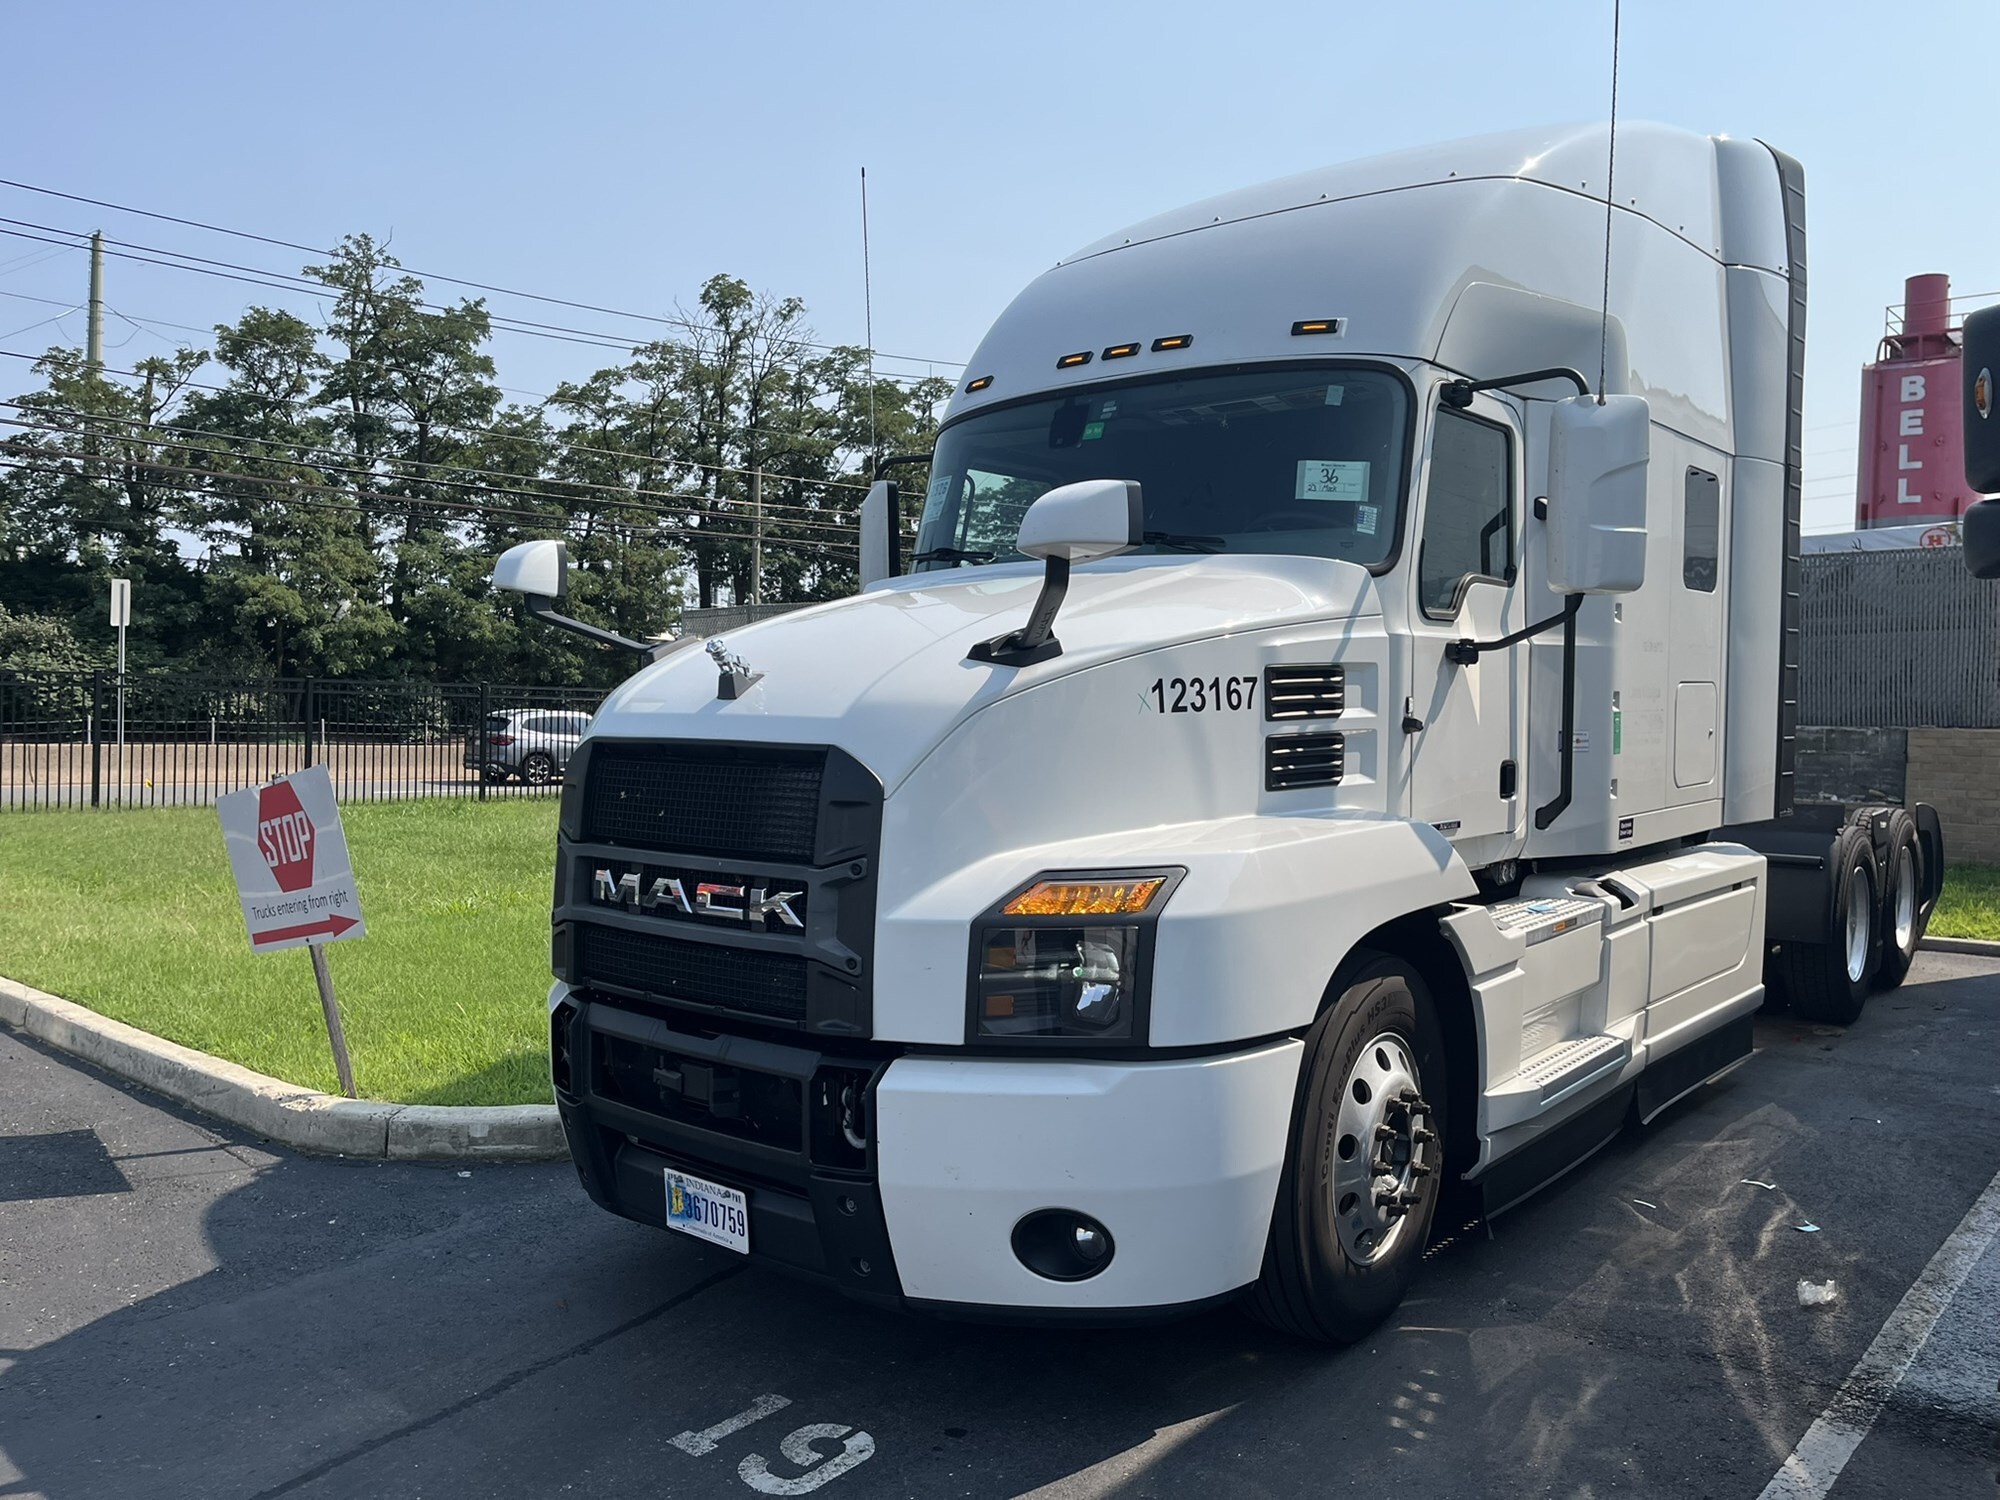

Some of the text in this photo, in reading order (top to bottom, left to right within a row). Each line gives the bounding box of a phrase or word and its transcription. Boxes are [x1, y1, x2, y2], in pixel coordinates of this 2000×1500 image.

[1897, 375, 1927, 504] BELL
[1319, 468, 1339, 484] 36
[1151, 676, 1258, 714] 123167
[259, 810, 311, 868] STOP
[251, 889, 349, 920] Trucks entering from right
[593, 868, 804, 928] MACK
[1320, 1112, 1336, 1180] Conti
[685, 1178, 722, 1197] INDIANA
[685, 1192, 745, 1238] 3670759
[665, 1392, 876, 1496] 19
